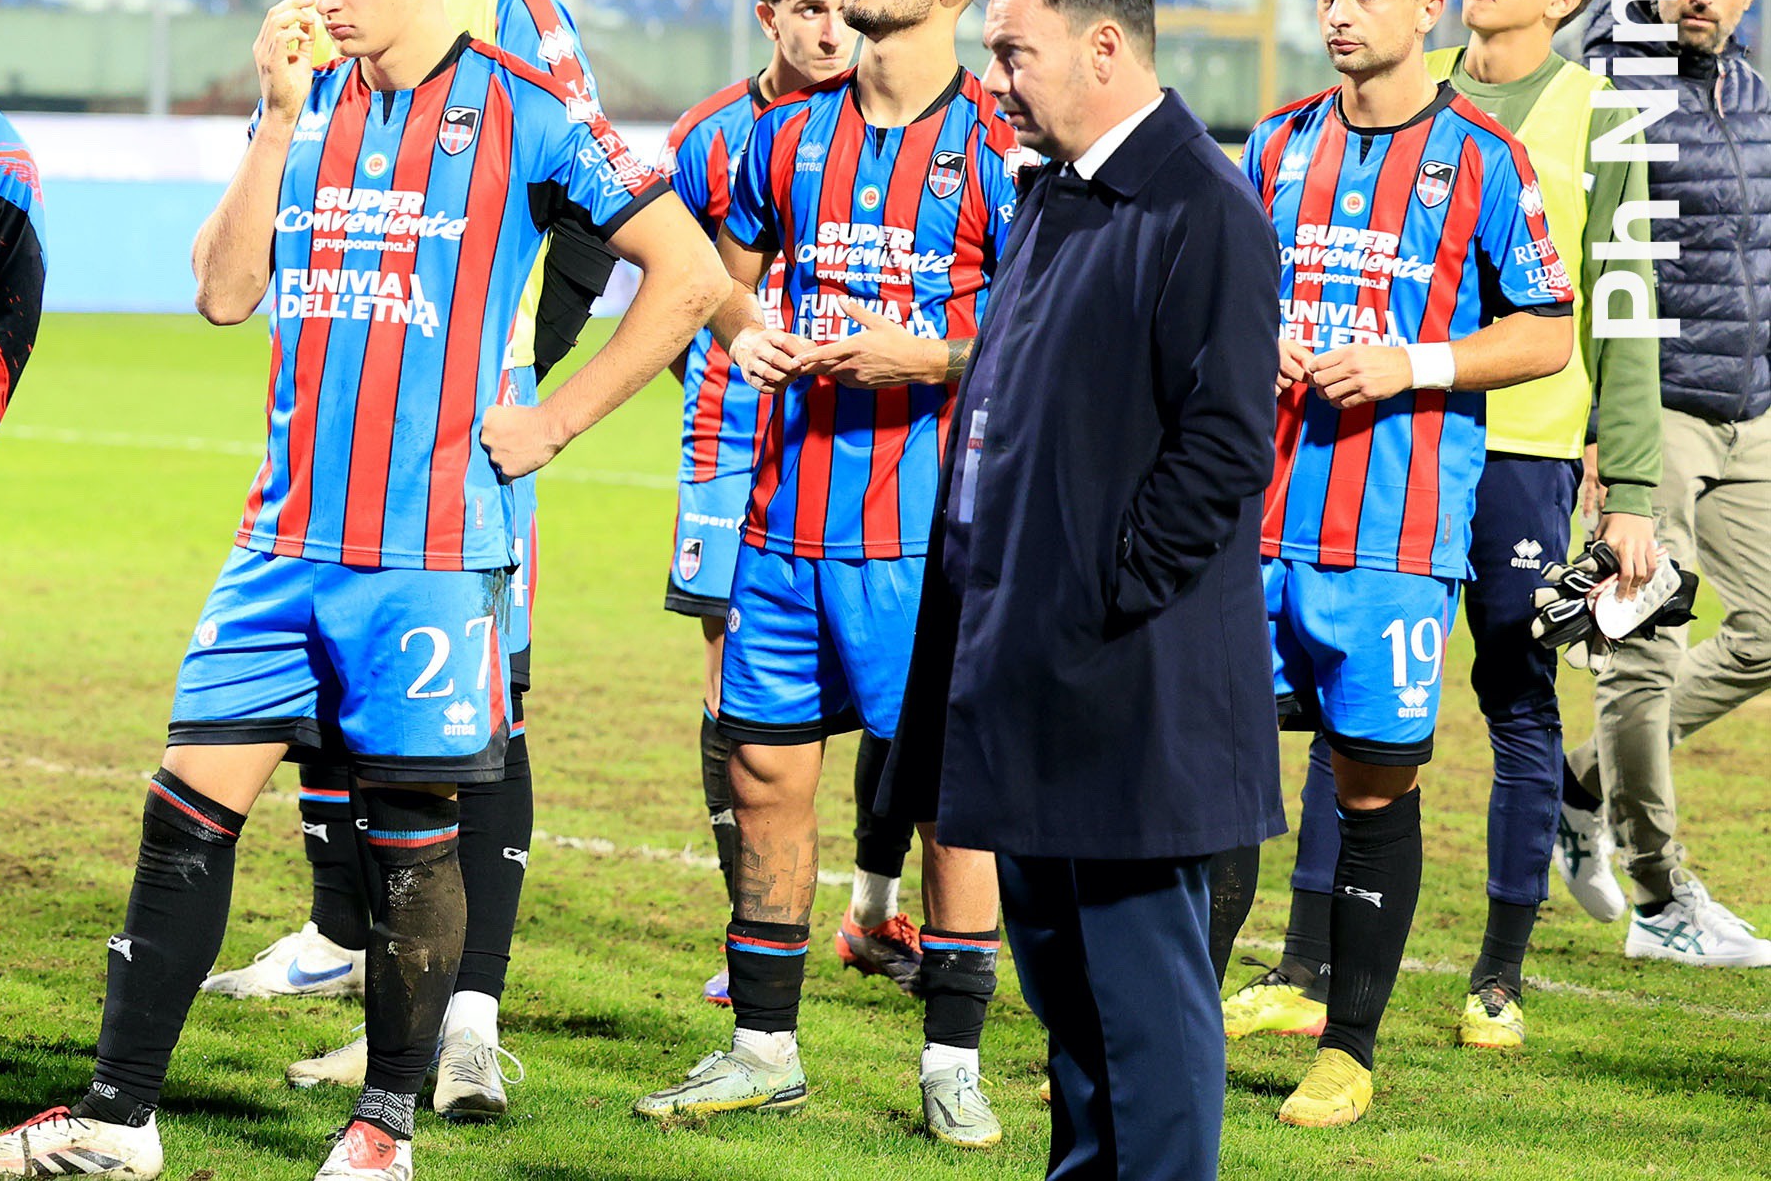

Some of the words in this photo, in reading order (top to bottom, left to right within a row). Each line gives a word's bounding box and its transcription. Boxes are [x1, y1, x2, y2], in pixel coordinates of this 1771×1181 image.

[315, 186, 425, 214] SUPER
[275, 205, 469, 240] Conveniente
[818, 222, 915, 251] SUPER
[312, 238, 416, 253] gruppoarena.it
[1296, 224, 1400, 255] SUPER
[1279, 242, 1436, 283] onveniente
[281, 268, 404, 298] FUNIVIA
[1295, 272, 1389, 291] gruppoarena.it
[279, 294, 440, 335] DELL'ETNA
[1511, 557, 1540, 569] errea
[400, 615, 493, 699] 27
[1381, 617, 1443, 687] 19
[1397, 707, 1428, 718] errea
[444, 724, 476, 736] errea
